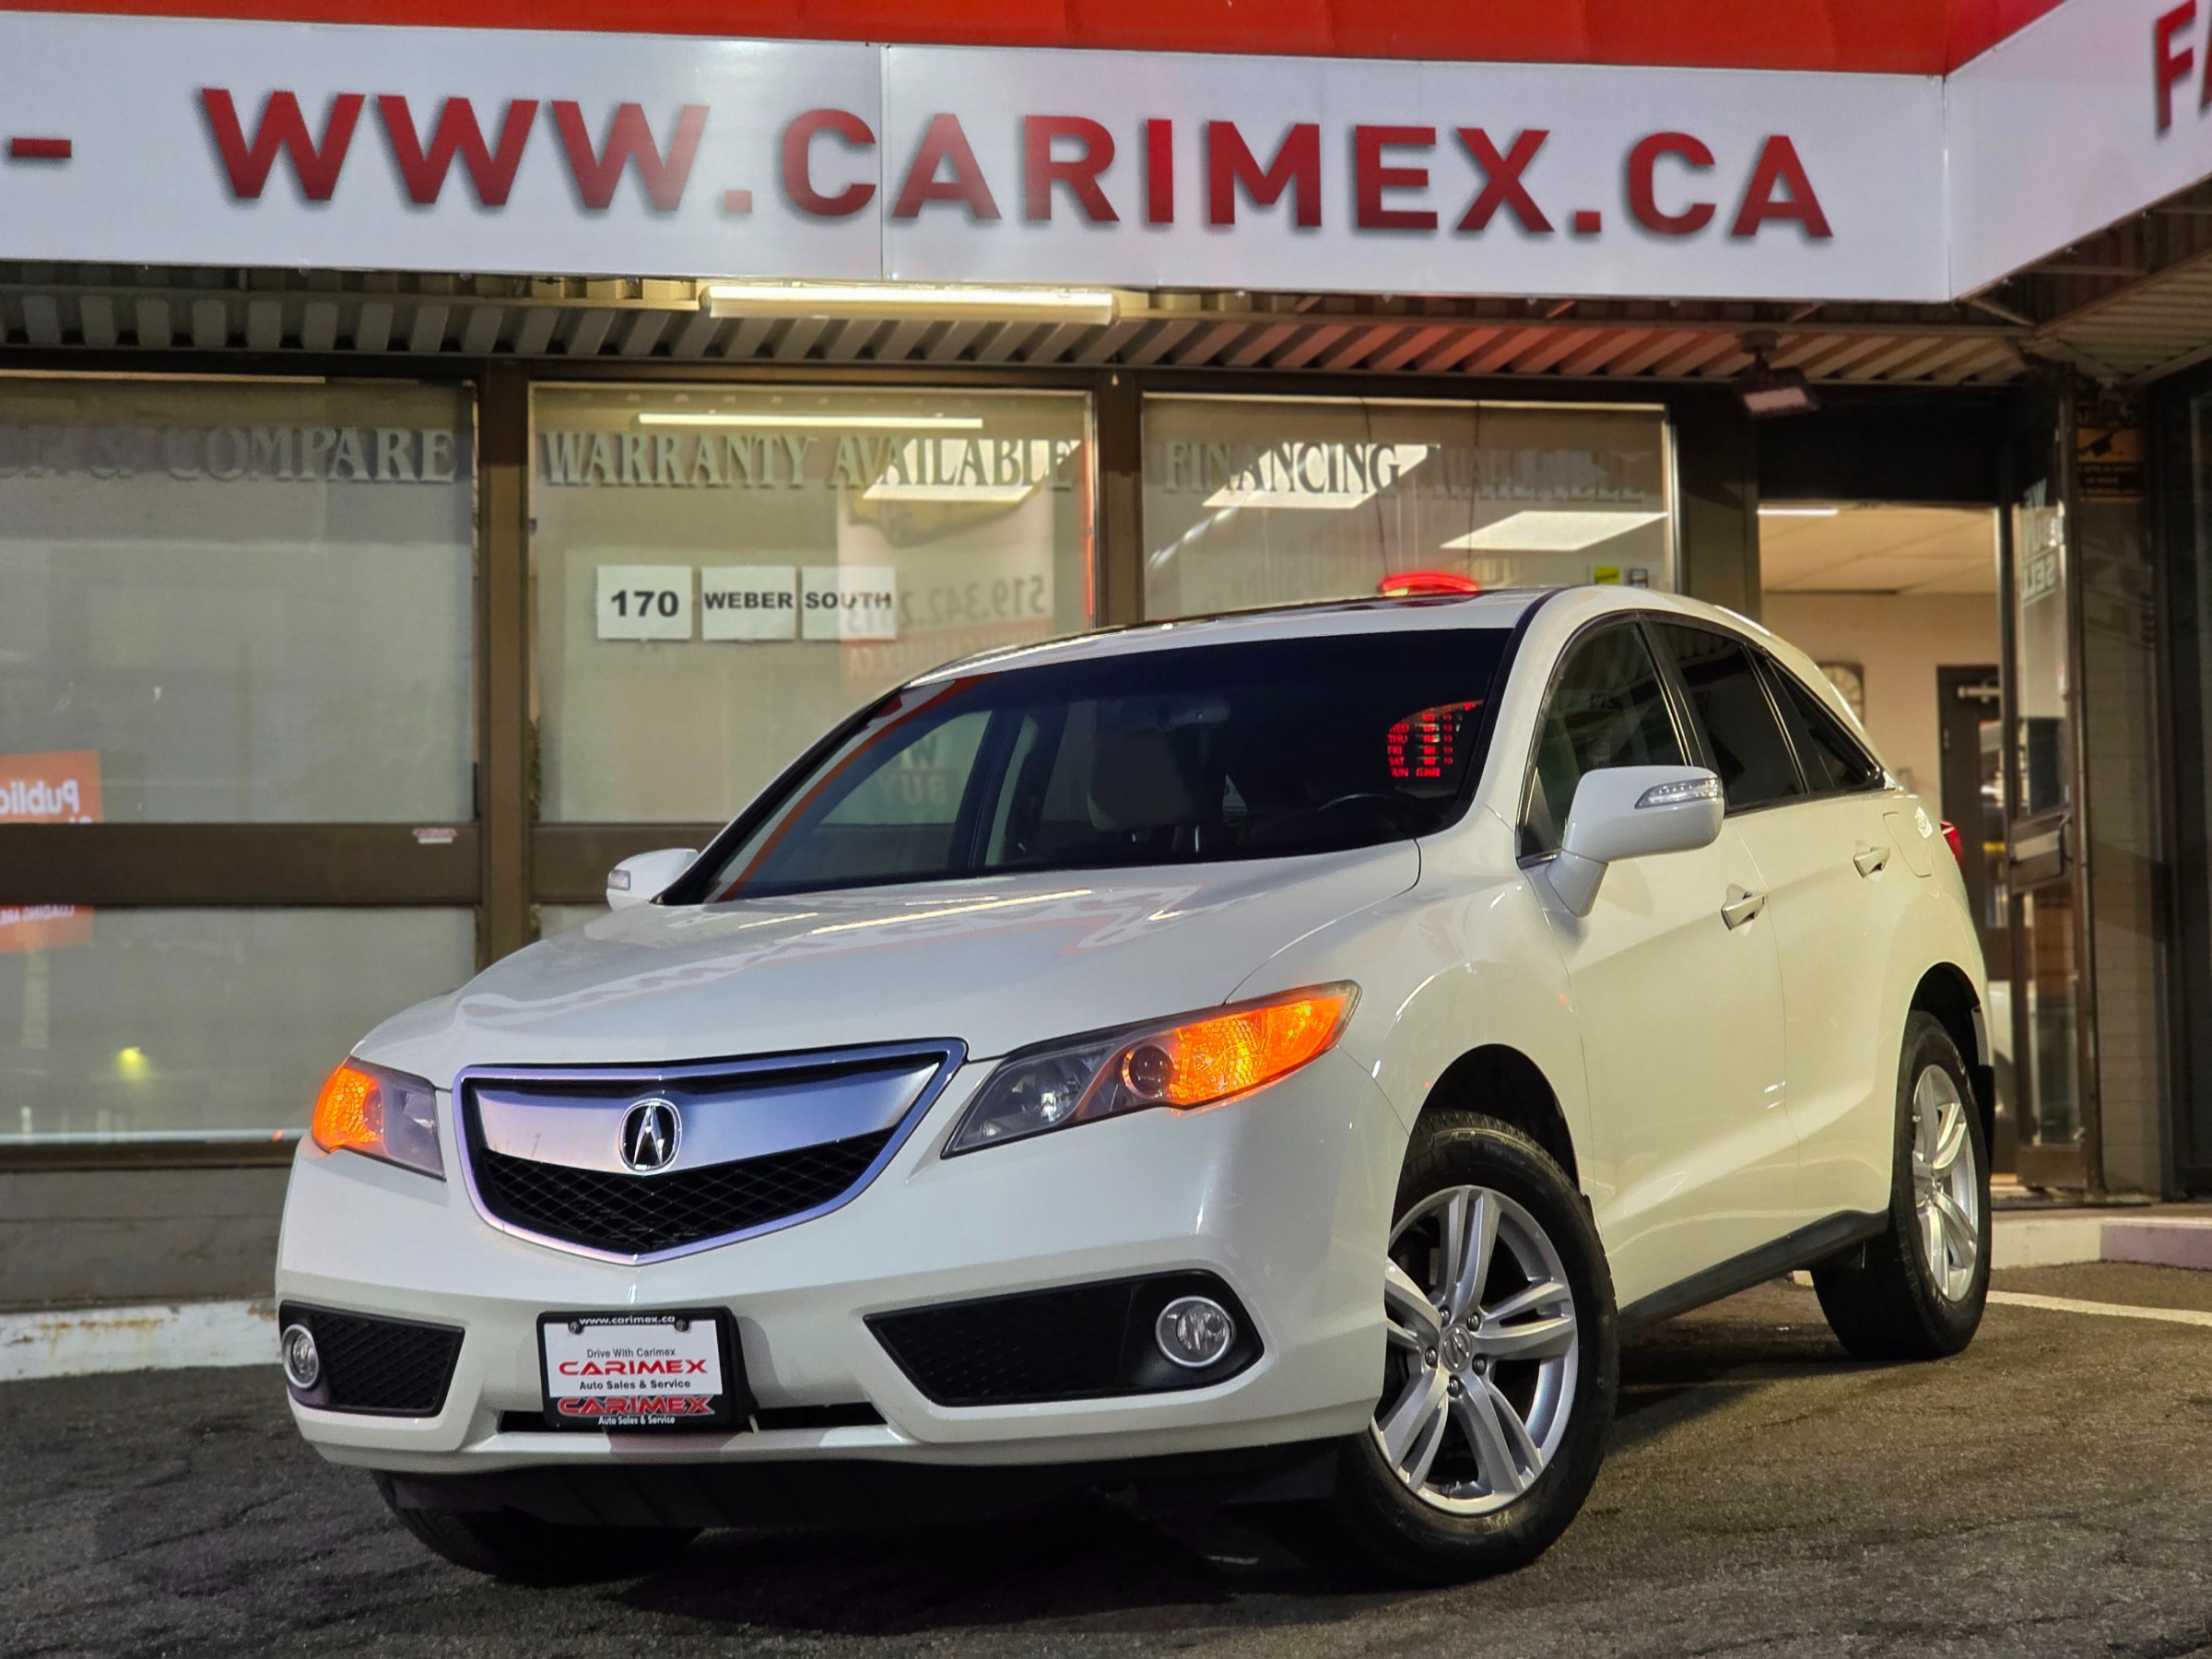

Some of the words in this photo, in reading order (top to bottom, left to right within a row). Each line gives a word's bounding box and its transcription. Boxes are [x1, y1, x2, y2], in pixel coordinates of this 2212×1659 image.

[202, 88, 1833, 238] WWW.CARIMEX.CA
[163, 426, 457, 483] COMPARE
[542, 430, 811, 488] WARRANTY
[830, 432, 1081, 490] AVAILABLE
[1163, 441, 1401, 496] FINANCING
[611, 590, 679, 618] 170
[704, 592, 794, 610] WEBER
[805, 592, 892, 610] SOUTH
[579, 1315, 676, 1325] www.carimex.ca
[587, 1348, 611, 1359] Drive
[612, 1347, 634, 1358] With
[636, 1347, 676, 1358] Carimex
[559, 1359, 708, 1376] CARIMEX
[580, 1381, 604, 1391] Auto
[606, 1381, 636, 1390] Sales
[640, 1380, 647, 1389] &
[651, 1380, 691, 1389] Service
[558, 1395, 715, 1417] CARIMEX
[598, 1416, 617, 1426] Auto
[618, 1416, 640, 1425] Sales
[641, 1415, 646, 1425] &
[648, 1415, 676, 1425] Service
